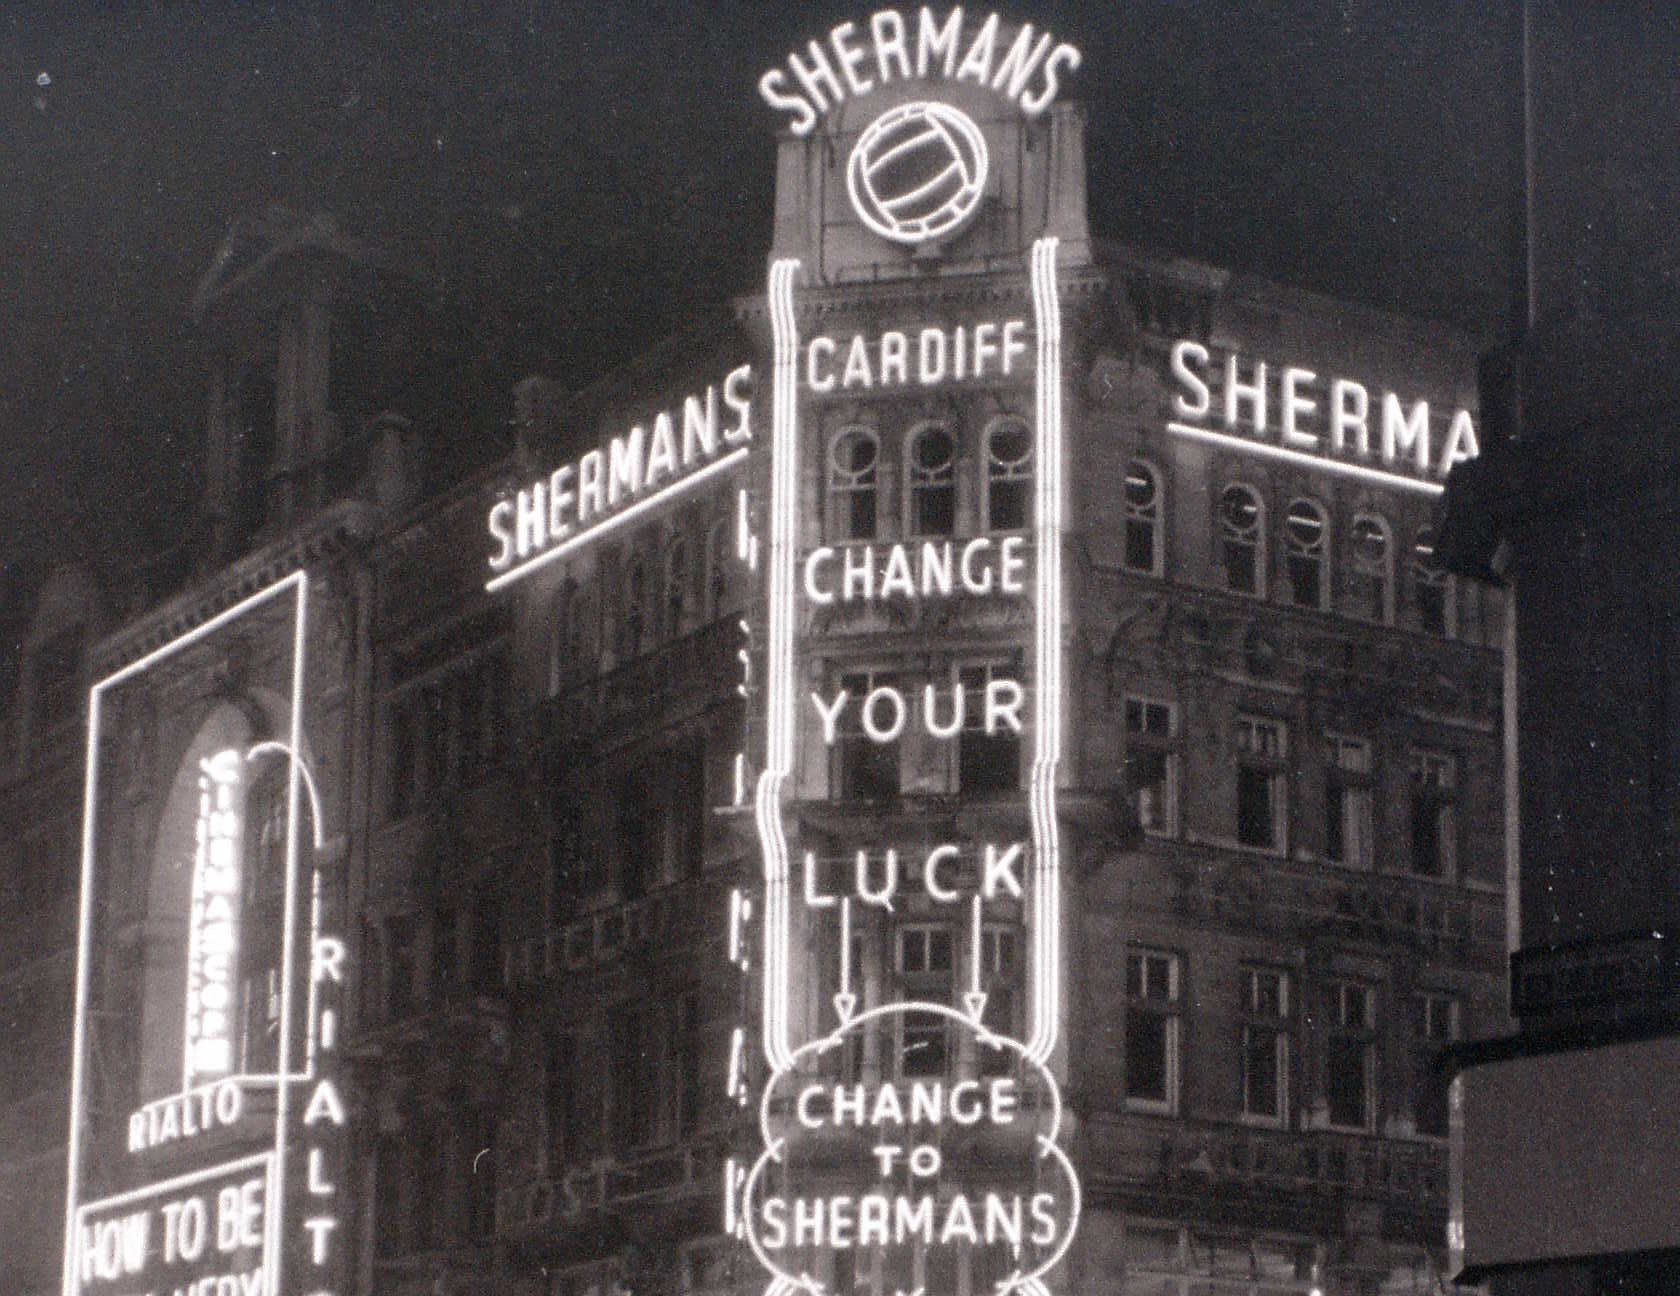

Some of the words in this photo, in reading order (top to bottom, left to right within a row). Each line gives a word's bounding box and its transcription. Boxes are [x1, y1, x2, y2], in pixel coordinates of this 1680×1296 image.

[758, 6, 1082, 136] SHERMANS
[807, 320, 1026, 393] CARDIFF
[1171, 340, 1480, 478] SHERMA
[489, 364, 753, 568] SHERMANS
[804, 536, 1026, 604] CHANGE
[810, 679, 1025, 745] YOUR
[804, 843, 1023, 913] LUCK
[128, 1080, 241, 1153] RIALTO
[797, 1079, 1015, 1128] CHANGE
[872, 1144, 942, 1178] TO
[80, 1211, 149, 1282] HOW
[161, 1198, 206, 1264] TO
[217, 1179, 264, 1253] BE
[761, 1193, 1057, 1249] SHERMANS
